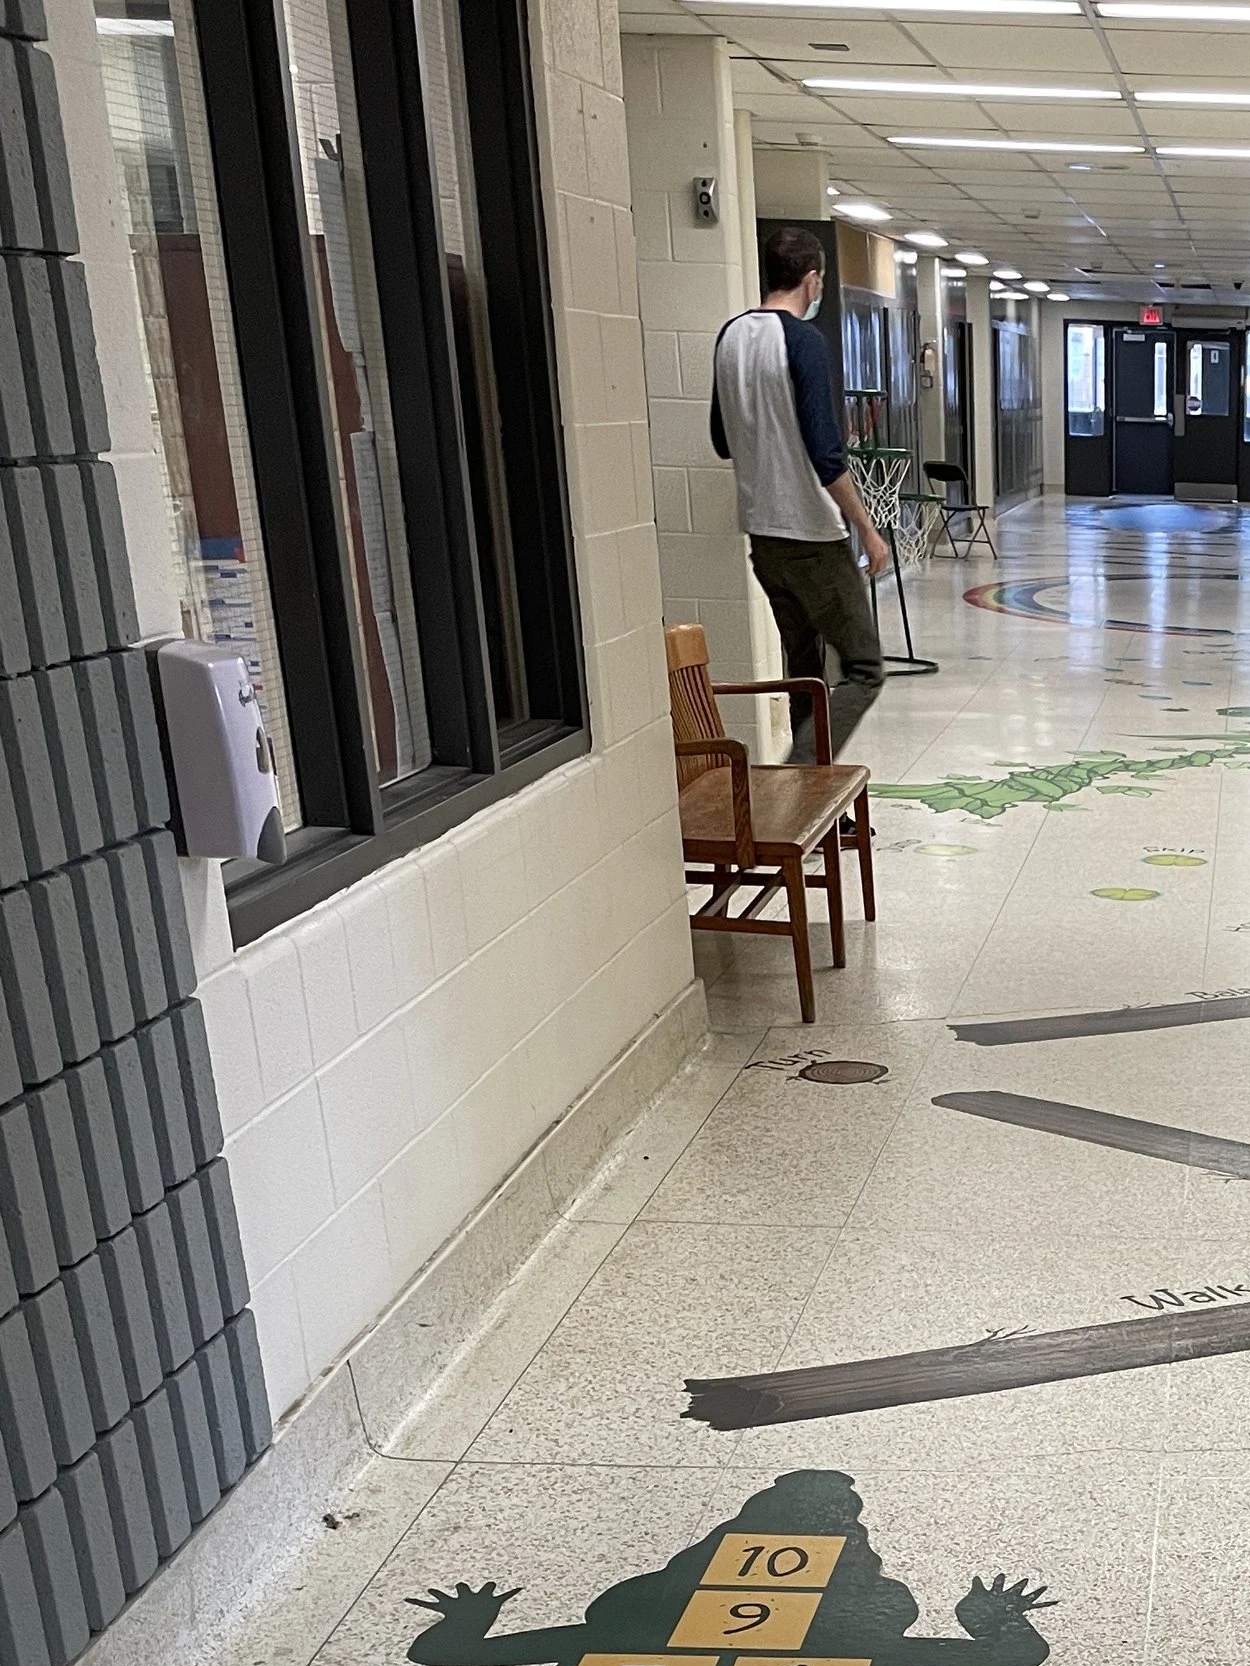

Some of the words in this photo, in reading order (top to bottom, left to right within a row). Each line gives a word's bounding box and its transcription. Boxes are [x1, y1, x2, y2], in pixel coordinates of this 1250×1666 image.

[744, 1049, 832, 1071] Turn
[737, 1546, 809, 1577] 10
[722, 1603, 771, 1635] 9
